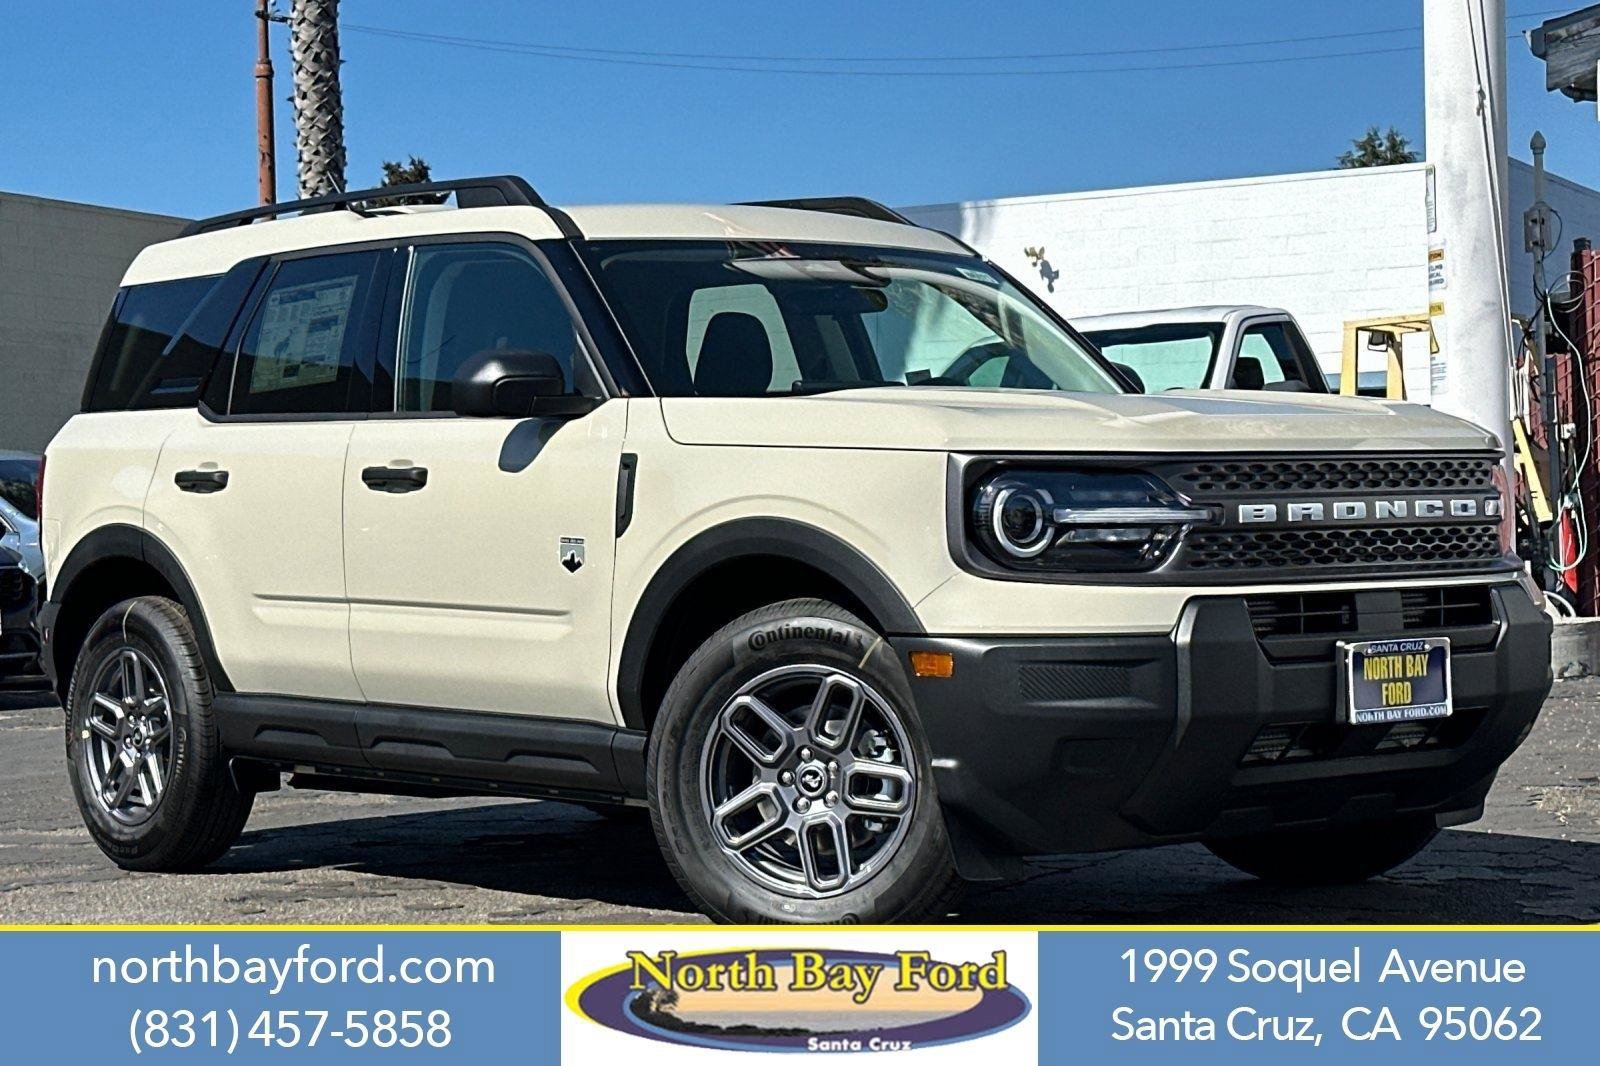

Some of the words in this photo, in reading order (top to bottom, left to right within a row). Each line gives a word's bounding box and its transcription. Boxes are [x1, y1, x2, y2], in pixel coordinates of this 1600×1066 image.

[1238, 500, 1477, 523] BRONCO
[1371, 643, 1399, 654] SANTA
[1400, 641, 1424, 652] CRUZ
[1363, 655, 1403, 680] NORTH
[1406, 653, 1429, 678] BAY
[1381, 681, 1412, 706] FORD
[1356, 711, 1385, 722] NORTH
[1387, 709, 1402, 719] BAY
